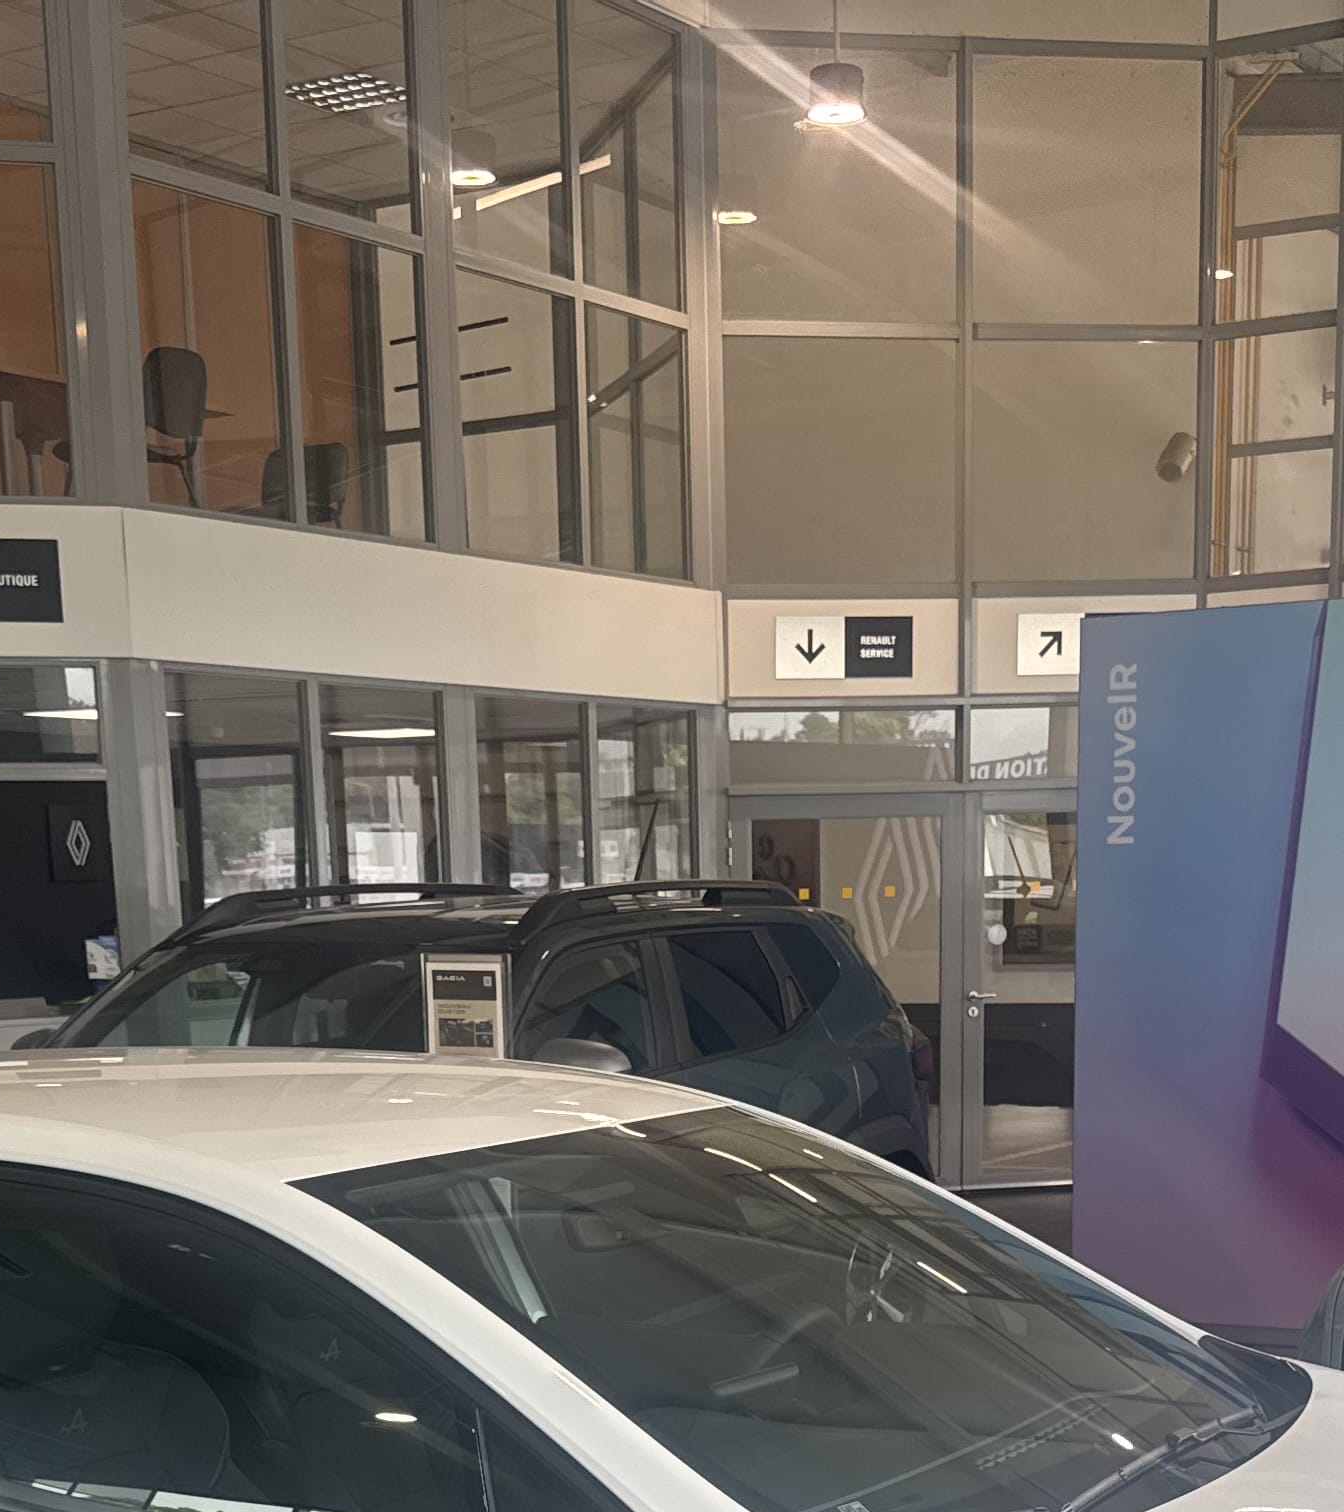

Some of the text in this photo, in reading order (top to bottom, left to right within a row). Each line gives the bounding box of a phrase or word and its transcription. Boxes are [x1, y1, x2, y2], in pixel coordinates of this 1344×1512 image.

[860, 635, 896, 645] RENAULT
[860, 648, 894, 658] SERVICE
[1106, 663, 1138, 845] NouvelR
